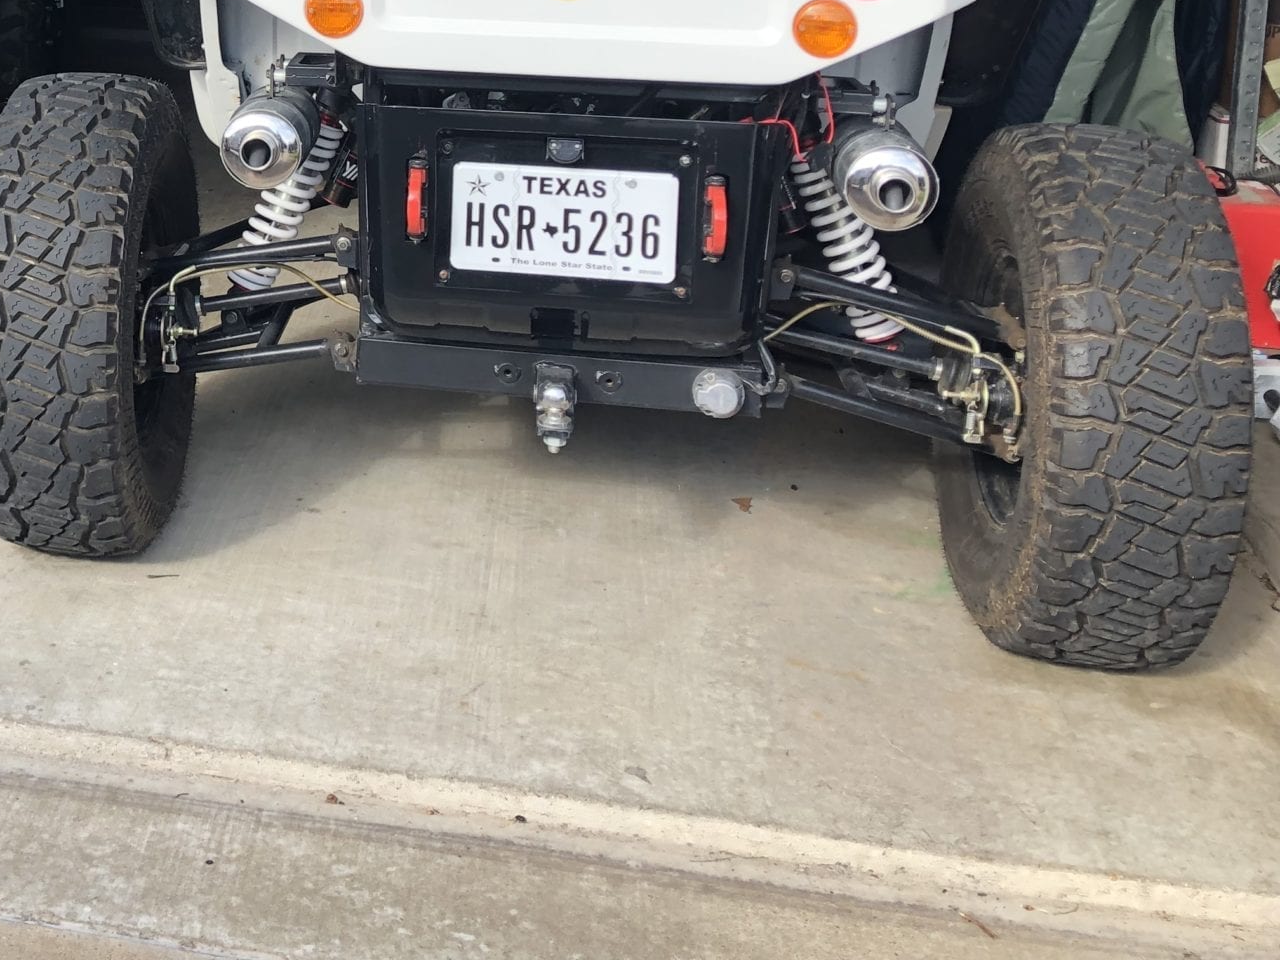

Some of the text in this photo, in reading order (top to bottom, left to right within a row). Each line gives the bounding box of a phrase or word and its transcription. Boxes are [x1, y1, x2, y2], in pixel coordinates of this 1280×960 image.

[523, 175, 607, 198] TEXAS
[510, 257, 613, 271] The Lone Star State
